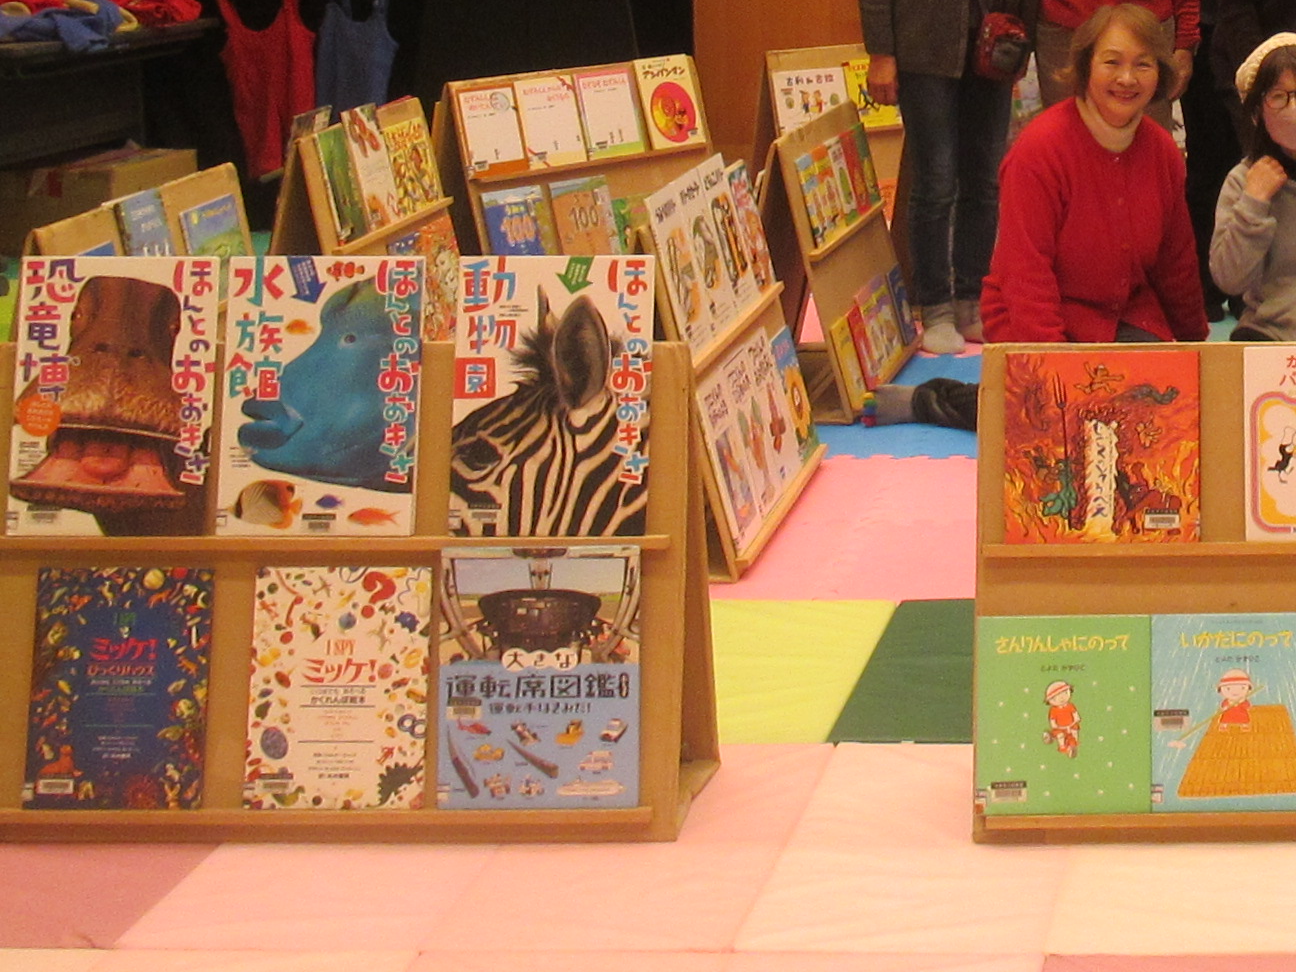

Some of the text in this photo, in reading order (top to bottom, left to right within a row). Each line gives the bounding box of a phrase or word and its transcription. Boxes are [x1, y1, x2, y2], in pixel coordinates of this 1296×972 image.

[225, 257, 285, 401] 水族館
[454, 256, 517, 399] 動物園
[172, 260, 218, 485] ほんとのおおきさ
[376, 260, 421, 484] ほんとのおおきさ
[607, 259, 653, 485] ほんとのおおきさ
[89, 637, 158, 661] ミッケ!
[995, 634, 1130, 655] さんりんしゃにのって
[1180, 630, 1293, 649] いかだにのって
[302, 657, 378, 684] ミッケ!
[505, 651, 572, 669] 大きな
[446, 673, 616, 701] 運転席図鑑
